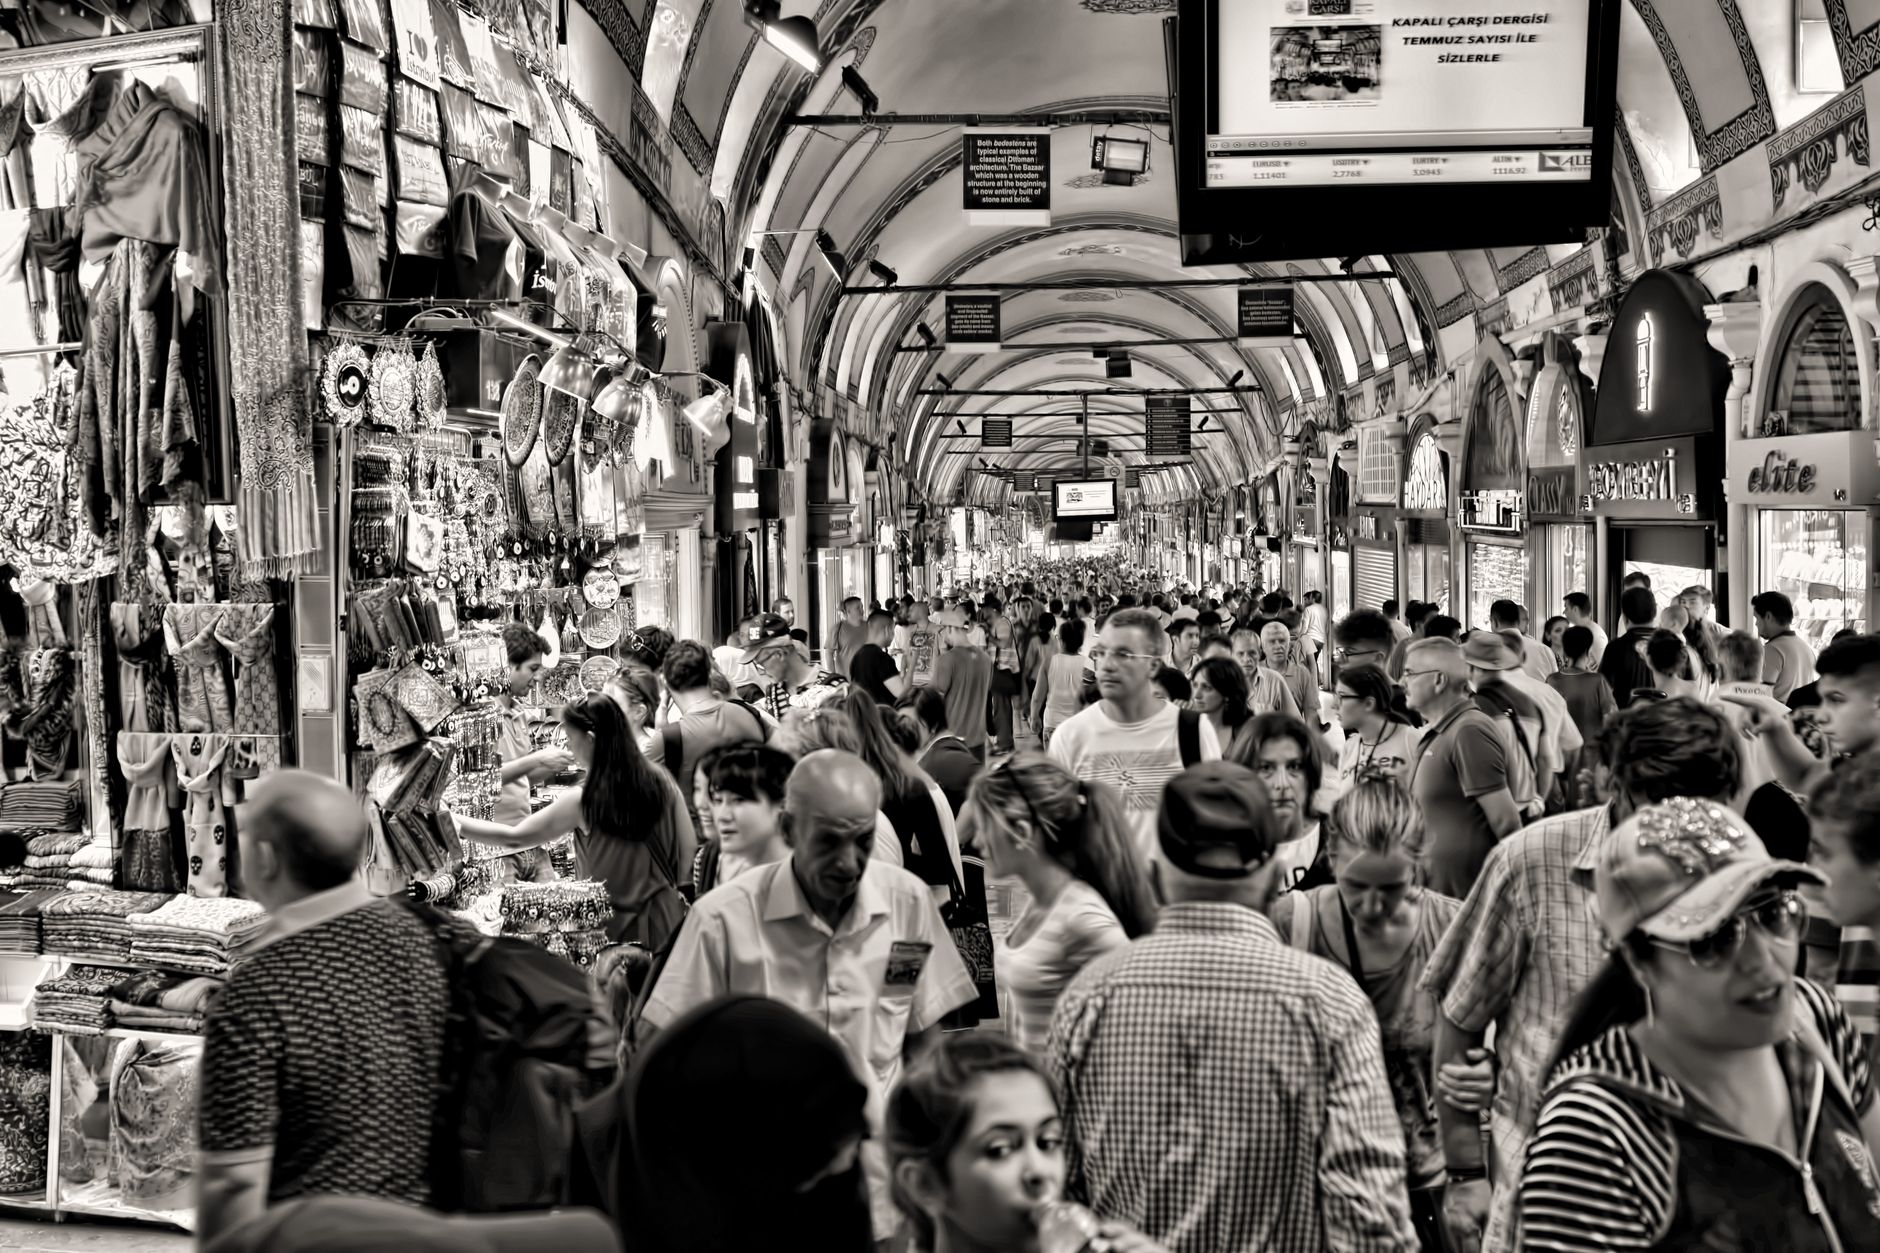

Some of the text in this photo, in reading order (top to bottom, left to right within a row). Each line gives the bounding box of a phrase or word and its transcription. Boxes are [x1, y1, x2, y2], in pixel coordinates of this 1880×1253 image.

[1392, 14, 1548, 27] KAPALI ÇARŞI DERGİSİ
[1403, 33, 1537, 45] TEMMUZ SAYISI İLE
[1438, 53, 1500, 63] SİZLERLE
[1016, 180, 1046, 188] beginning
[995, 188, 1017, 196] entirely
